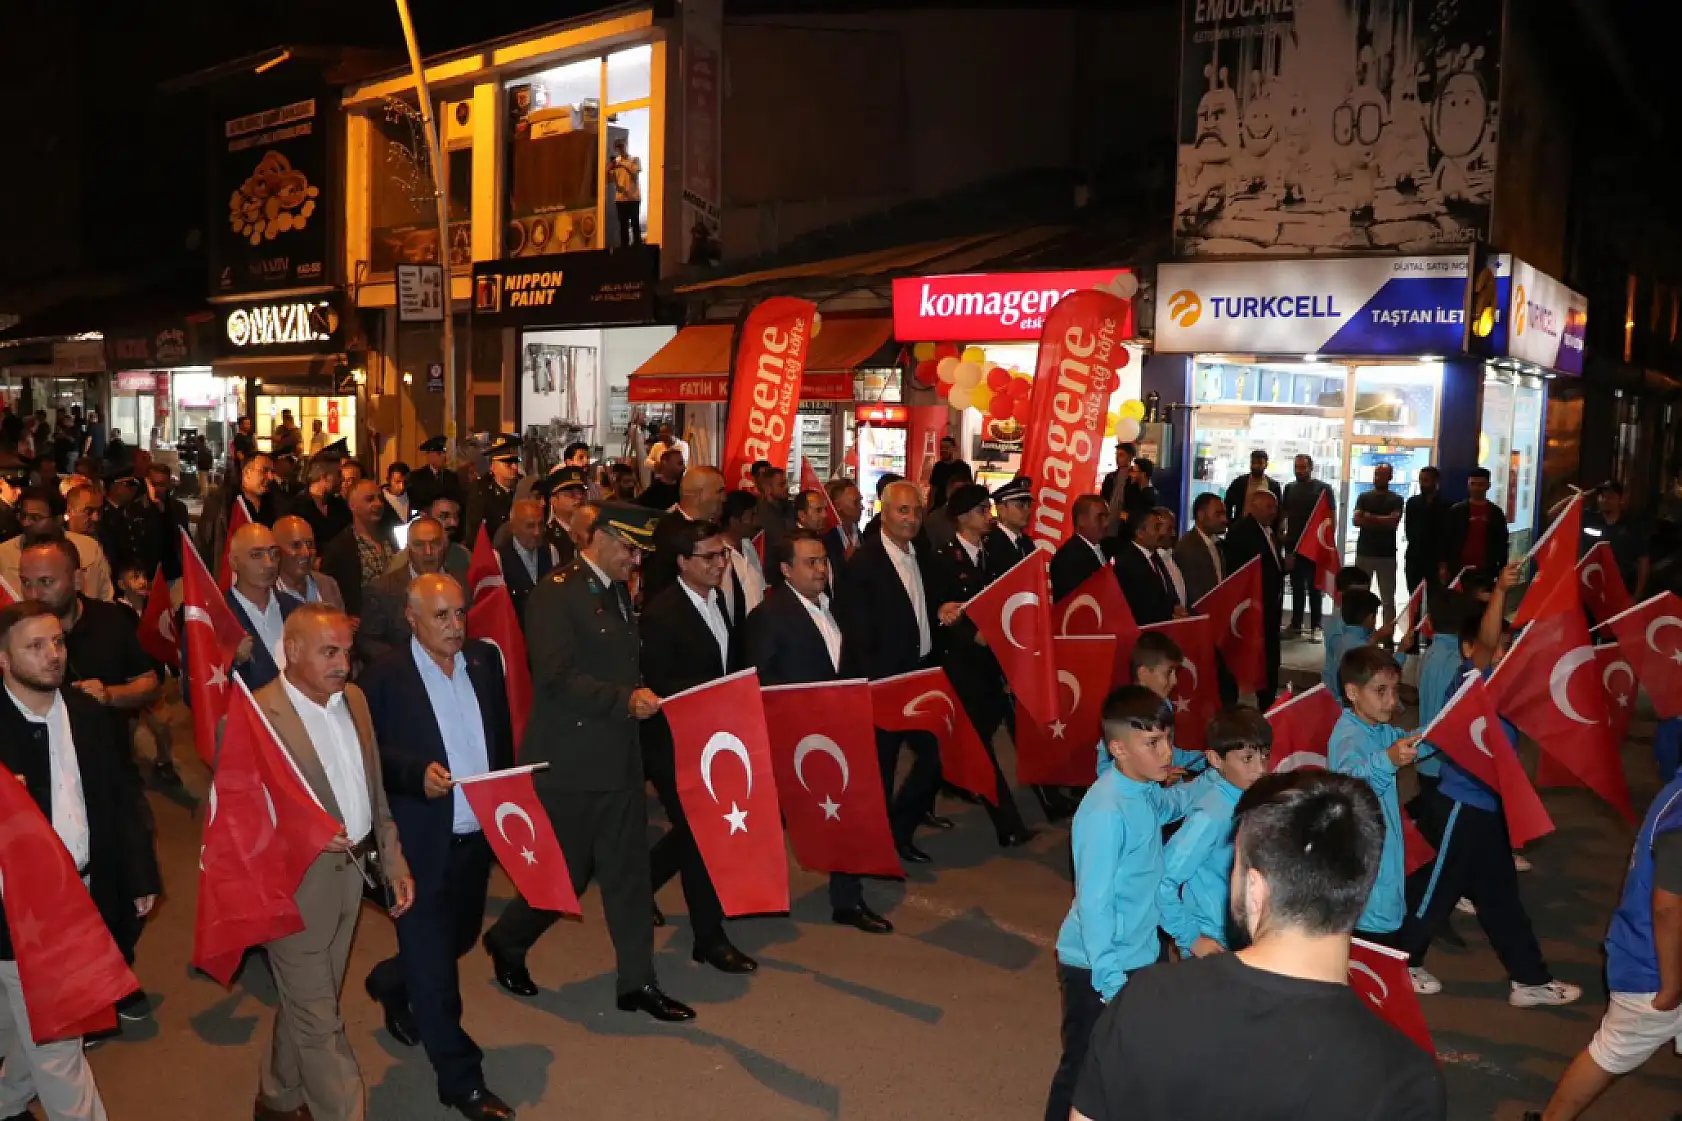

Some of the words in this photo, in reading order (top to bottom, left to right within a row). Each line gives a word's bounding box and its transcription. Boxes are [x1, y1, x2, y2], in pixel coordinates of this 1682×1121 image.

[1451, 261, 1468, 270] NO
[505, 271, 563, 289] NIPPON
[511, 289, 556, 306] PAINT
[1211, 295, 1341, 318] TURKCELL
[1020, 317, 1045, 329] etsi
[1372, 309, 1431, 327] TAŞTAN
[1436, 306, 1500, 323] İLETM
[679, 383, 712, 396] FATİH
